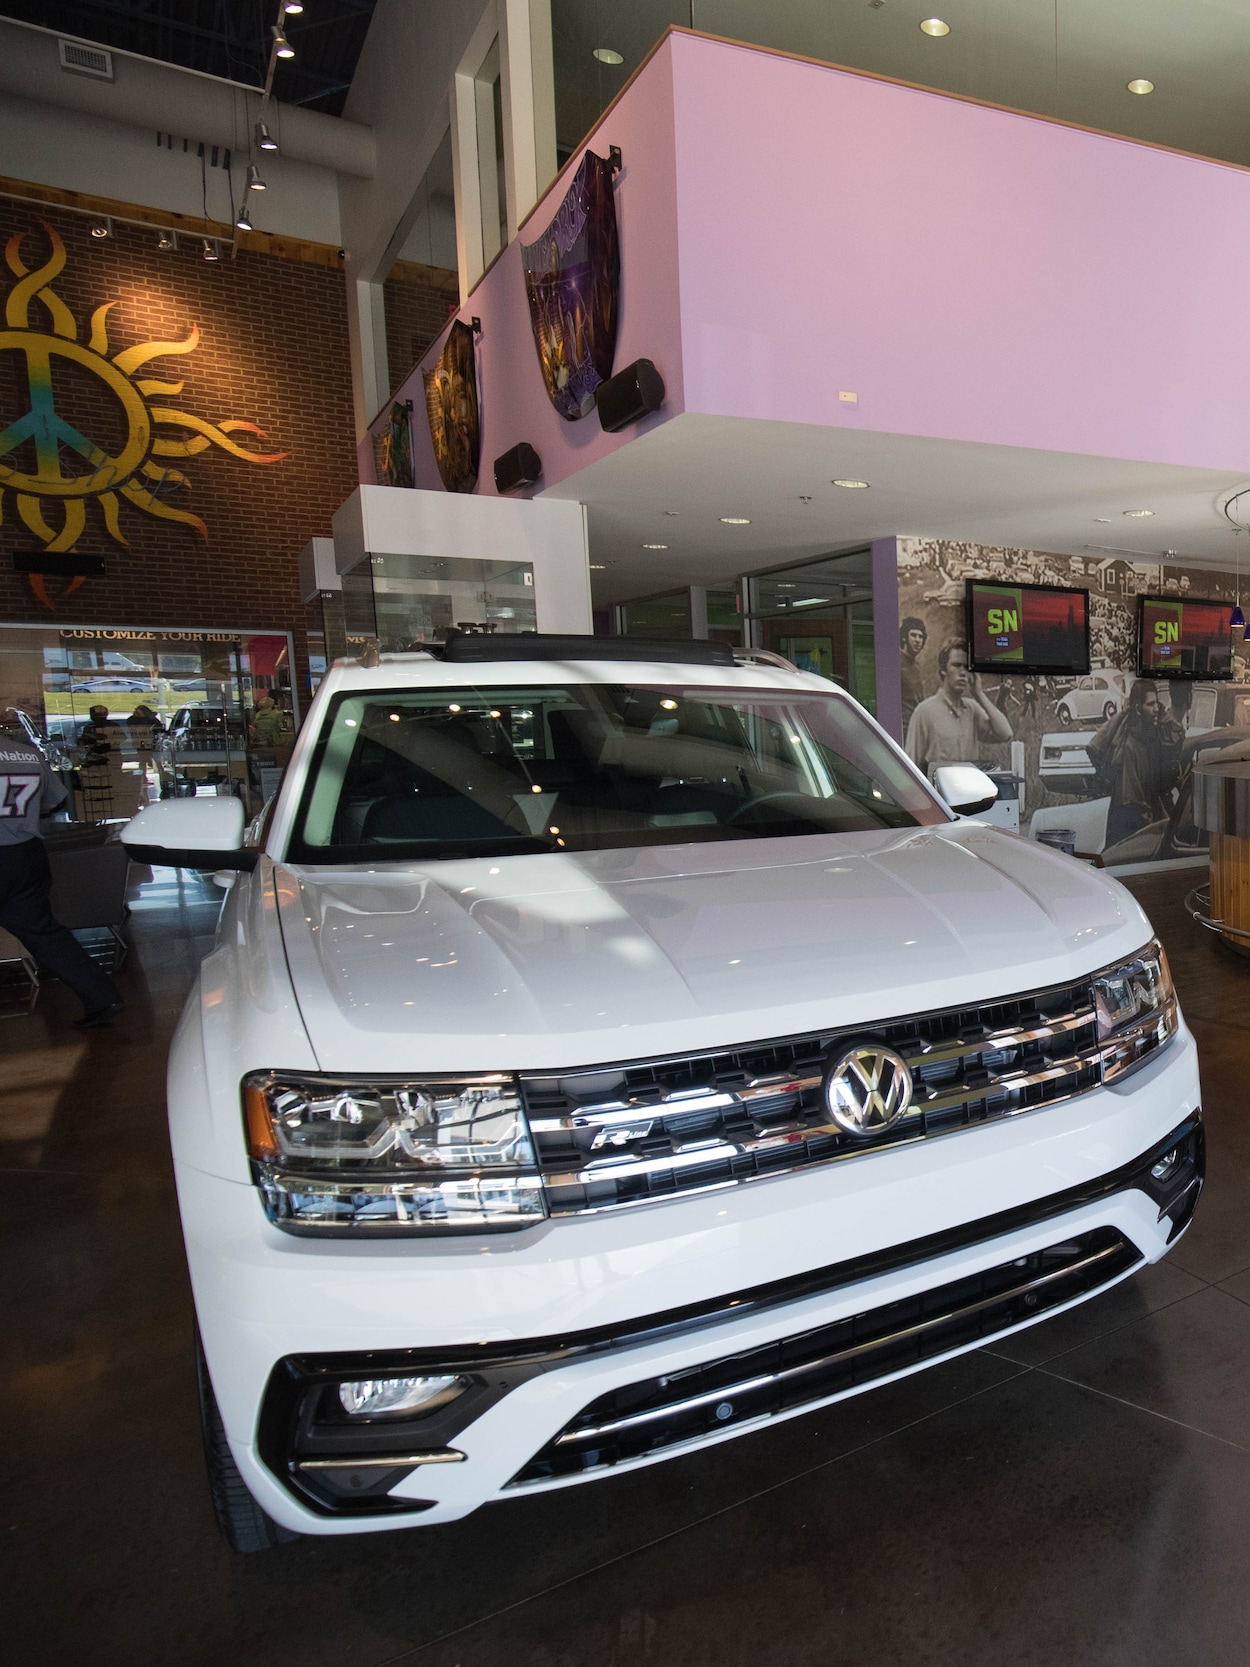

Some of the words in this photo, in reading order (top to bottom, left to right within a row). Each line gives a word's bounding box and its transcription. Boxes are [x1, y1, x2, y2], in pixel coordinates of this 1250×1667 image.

[987, 608, 1018, 635] SN
[59, 629, 156, 641] CUSTOMIZE
[161, 631, 203, 642] YOUR
[206, 633, 241, 643] RIDE
[1154, 621, 1179, 645] SN
[0, 751, 39, 762] Nation
